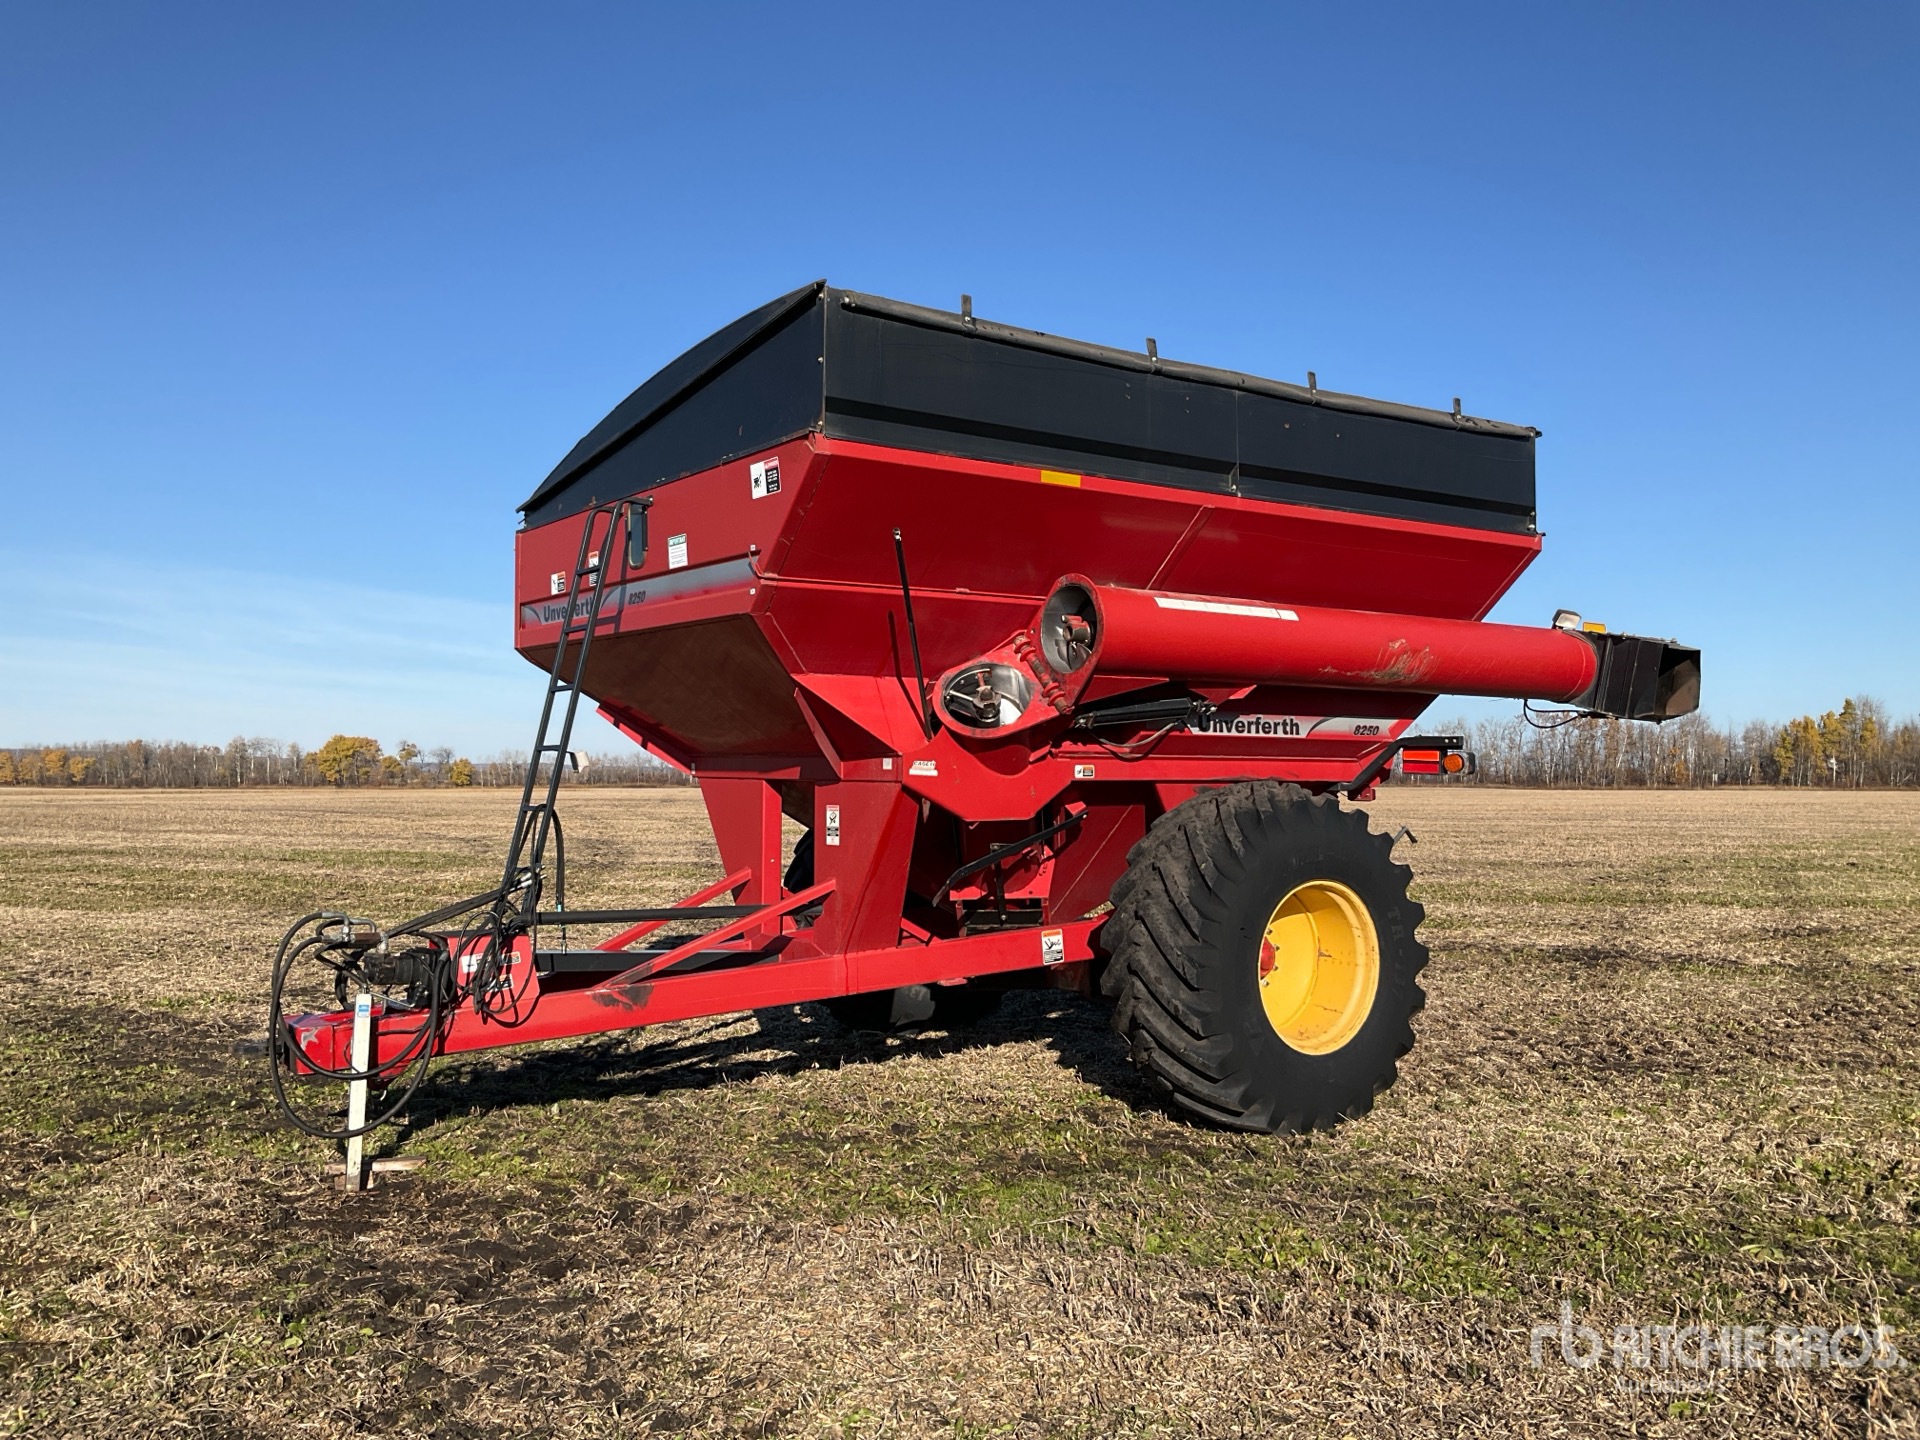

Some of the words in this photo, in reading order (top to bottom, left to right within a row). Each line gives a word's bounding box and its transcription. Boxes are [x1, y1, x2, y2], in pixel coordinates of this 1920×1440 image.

[628, 590, 646, 605] 8250
[1198, 714, 1300, 736] Unverferth
[1353, 724, 1380, 736] 8250
